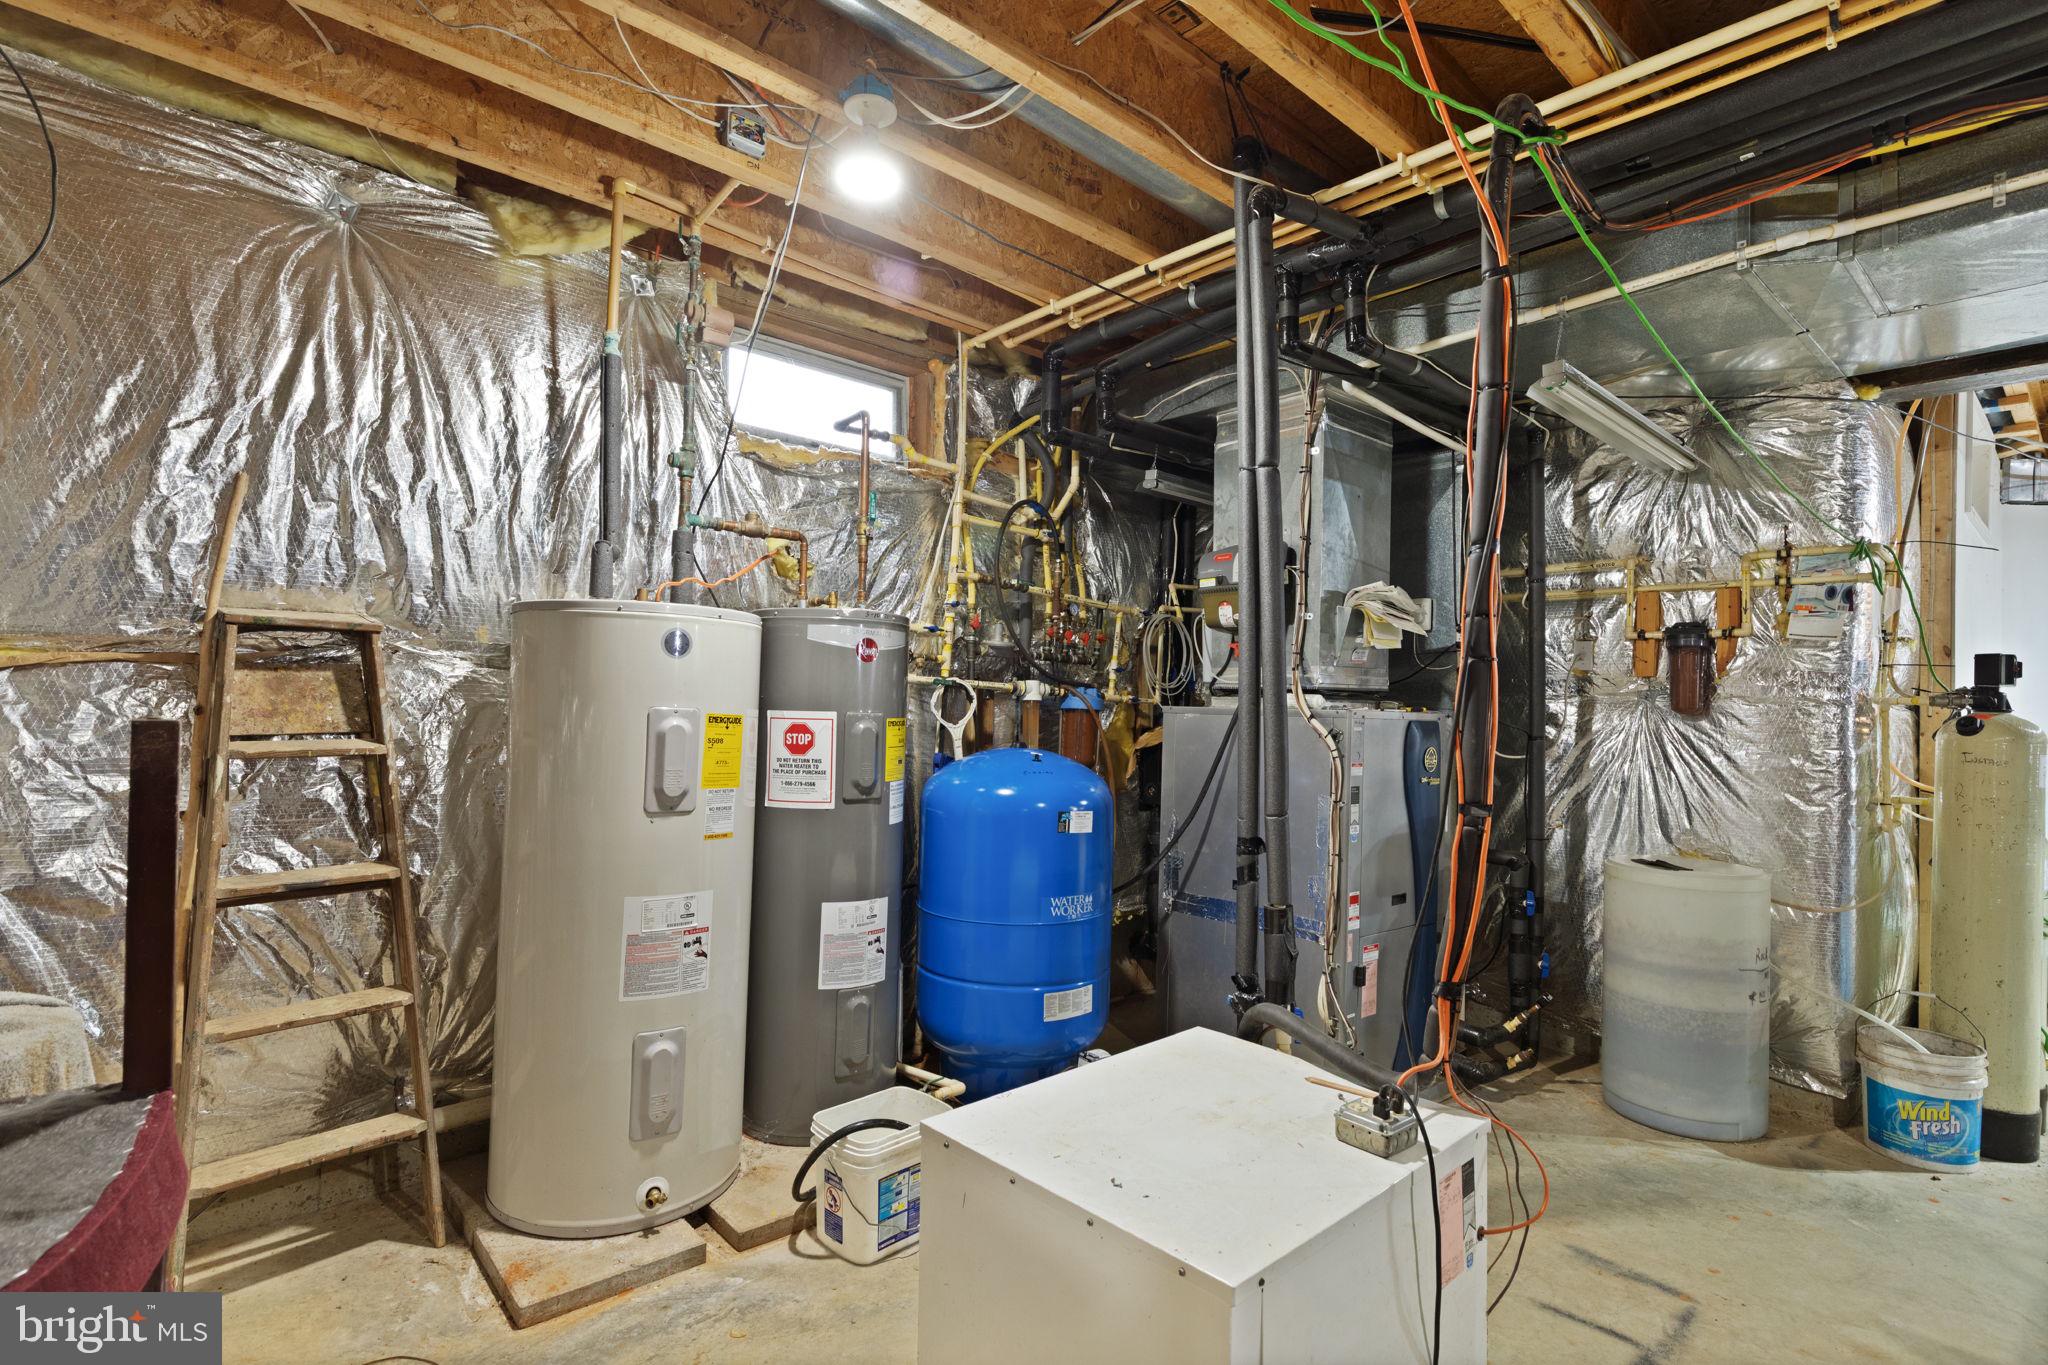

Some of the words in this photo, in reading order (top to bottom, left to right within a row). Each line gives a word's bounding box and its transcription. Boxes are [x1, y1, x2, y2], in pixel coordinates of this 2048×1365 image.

[786, 733, 811, 745] STOP
[1050, 895, 1085, 906] WATER
[1050, 903, 1093, 917] WORKER
[1897, 1099, 1950, 1120] Wind
